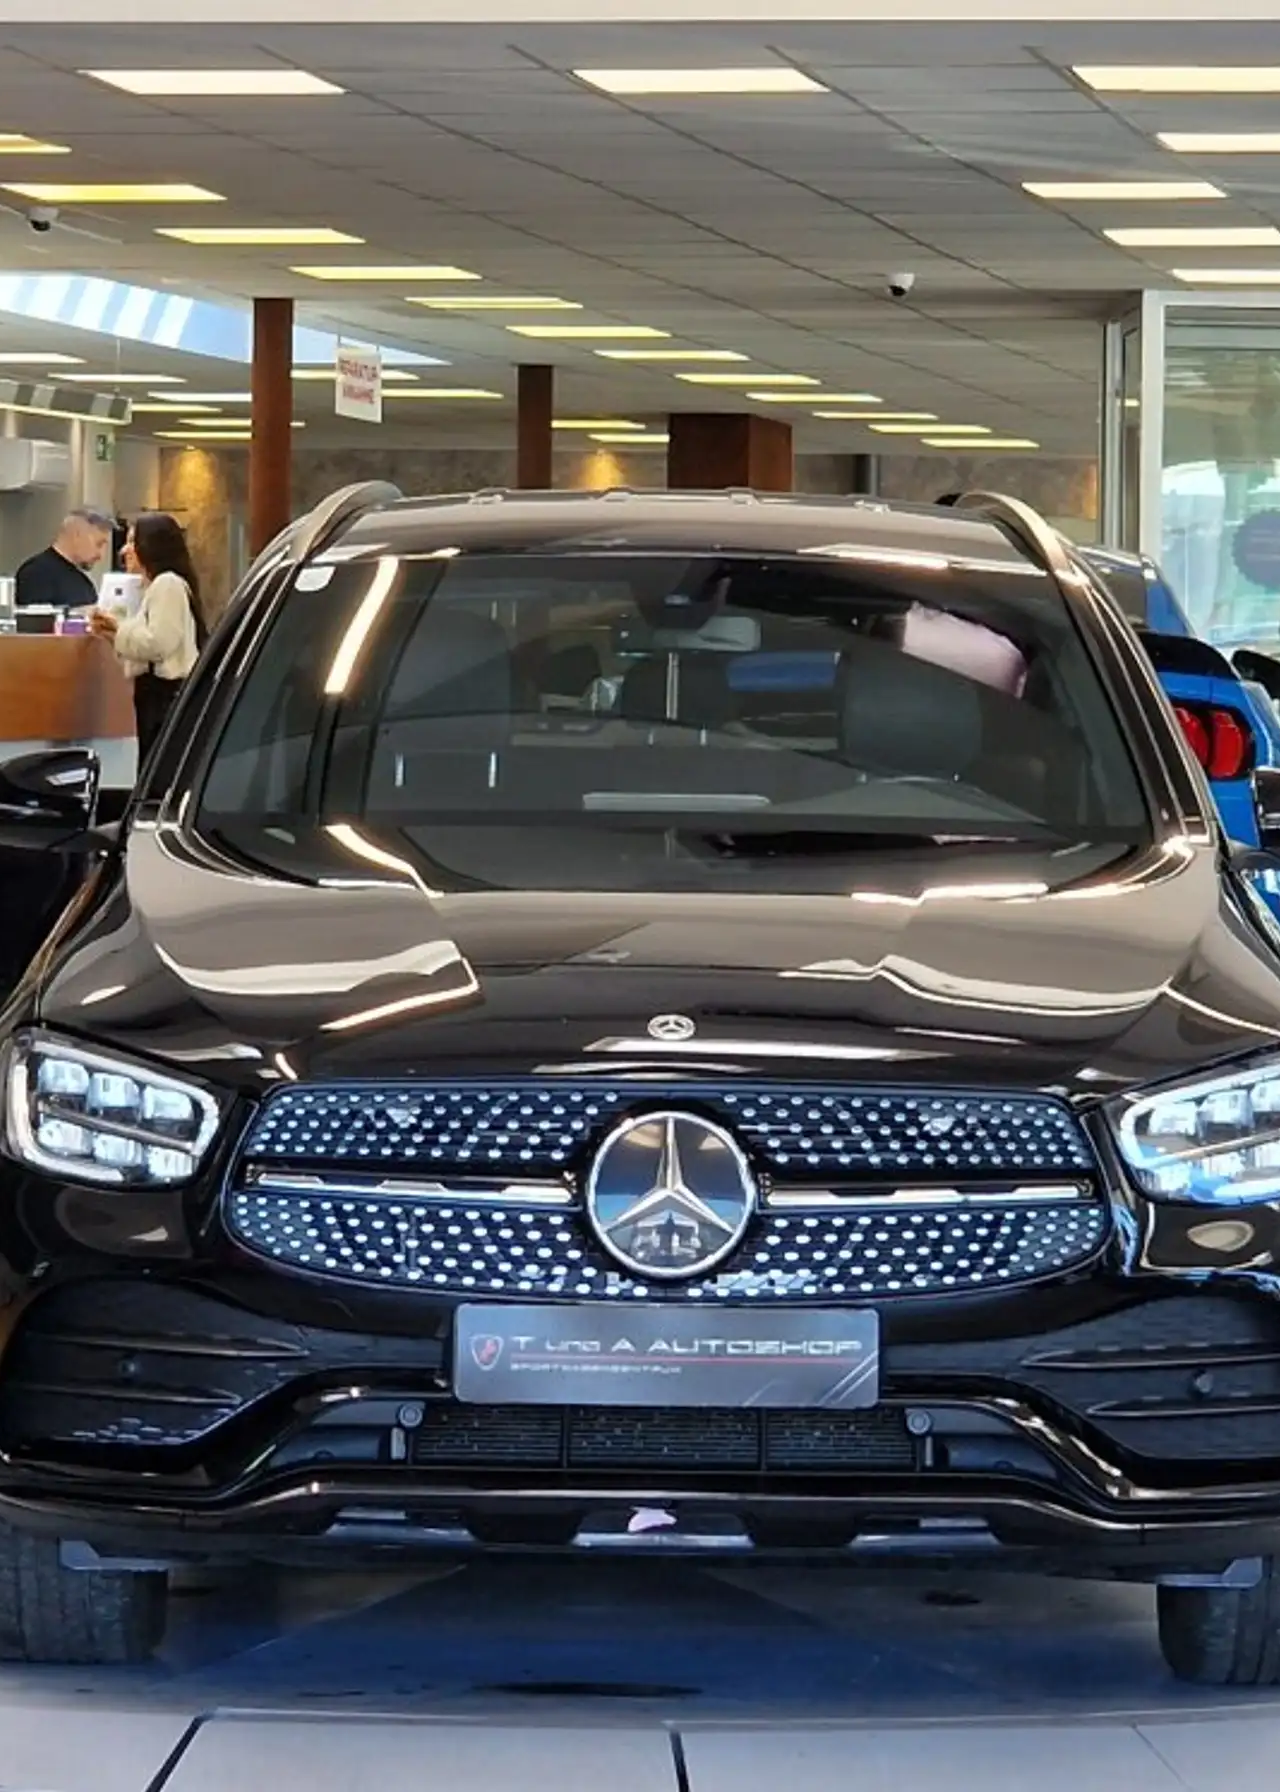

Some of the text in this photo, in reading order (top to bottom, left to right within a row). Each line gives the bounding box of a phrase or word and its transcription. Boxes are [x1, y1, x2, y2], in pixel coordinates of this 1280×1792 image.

[511, 1335, 536, 1352] T
[611, 1337, 637, 1353] A
[648, 1337, 863, 1356] AUTOSHOP
